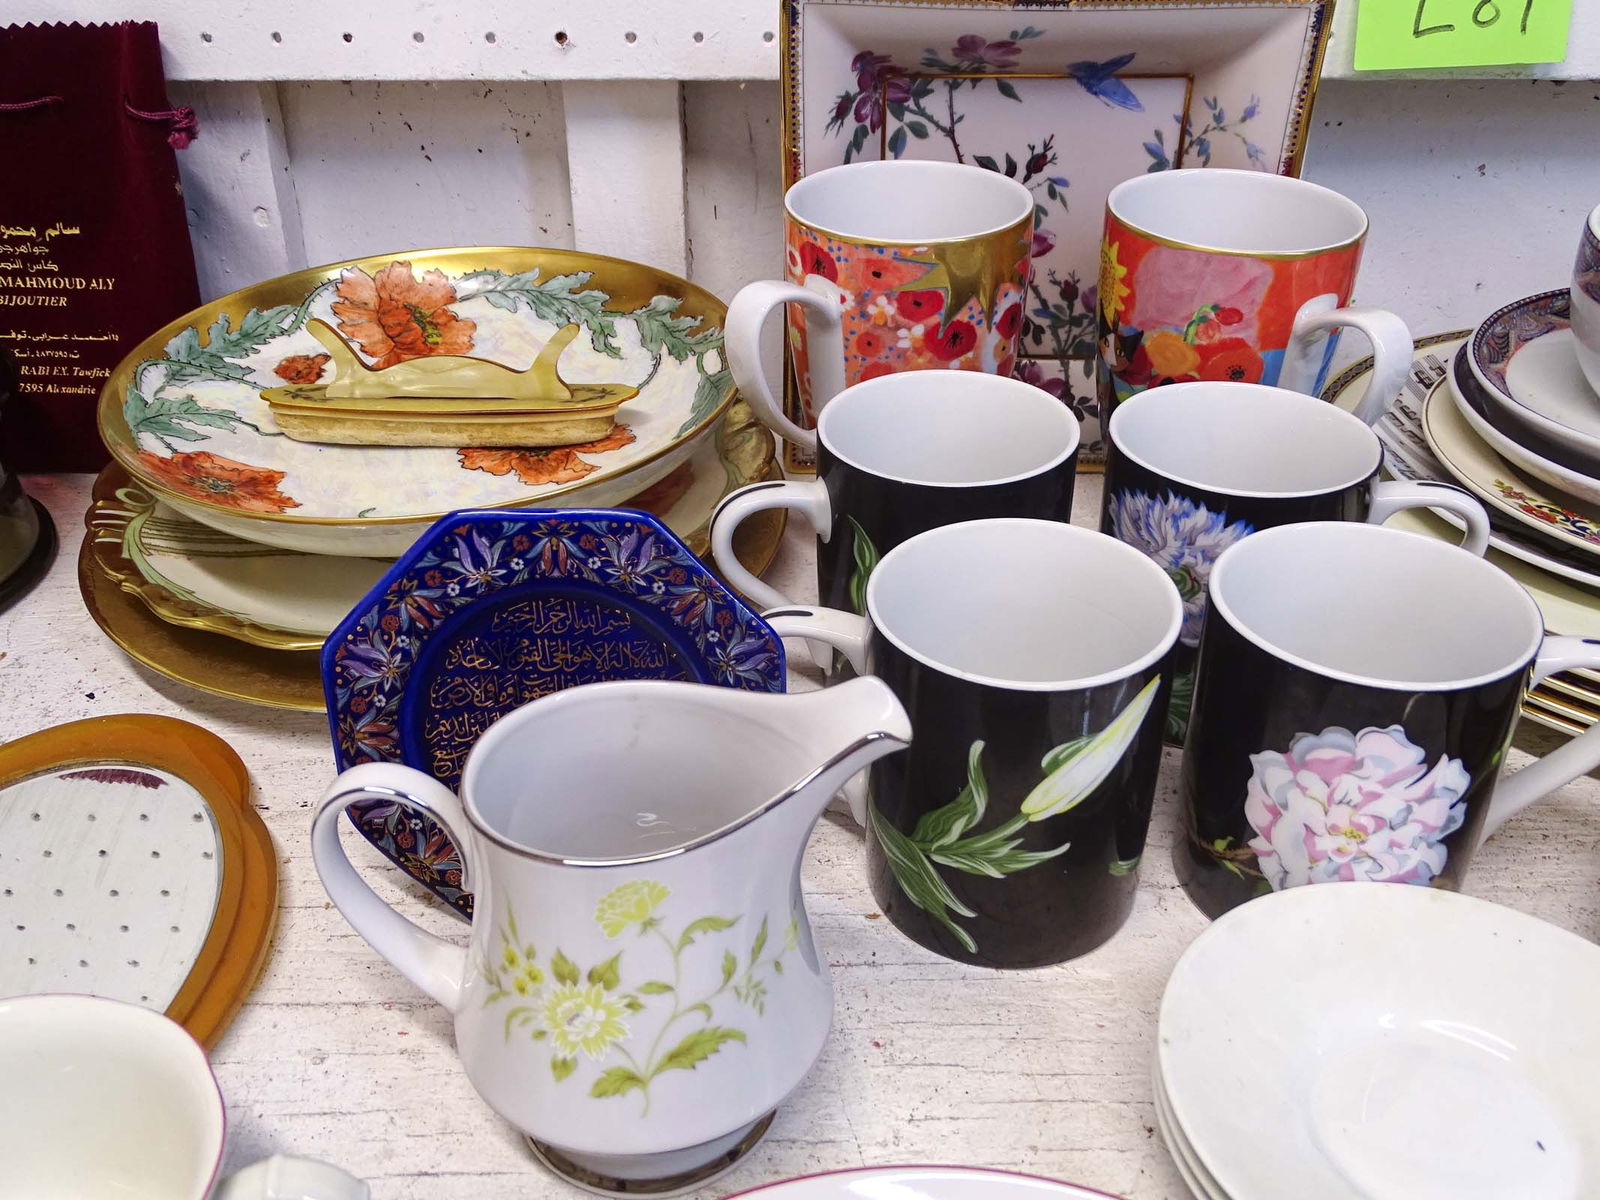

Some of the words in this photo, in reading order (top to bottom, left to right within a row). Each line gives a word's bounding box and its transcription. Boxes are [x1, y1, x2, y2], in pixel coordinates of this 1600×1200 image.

[0, 225, 37, 239] محمو
[45, 222, 80, 241] سالم
[0, 258, 23, 271] النص
[0, 276, 86, 290] MAHMOUD
[89, 277, 115, 291] ALY
[73, 366, 111, 379] Tawfick
[19, 382, 44, 393] 7595
